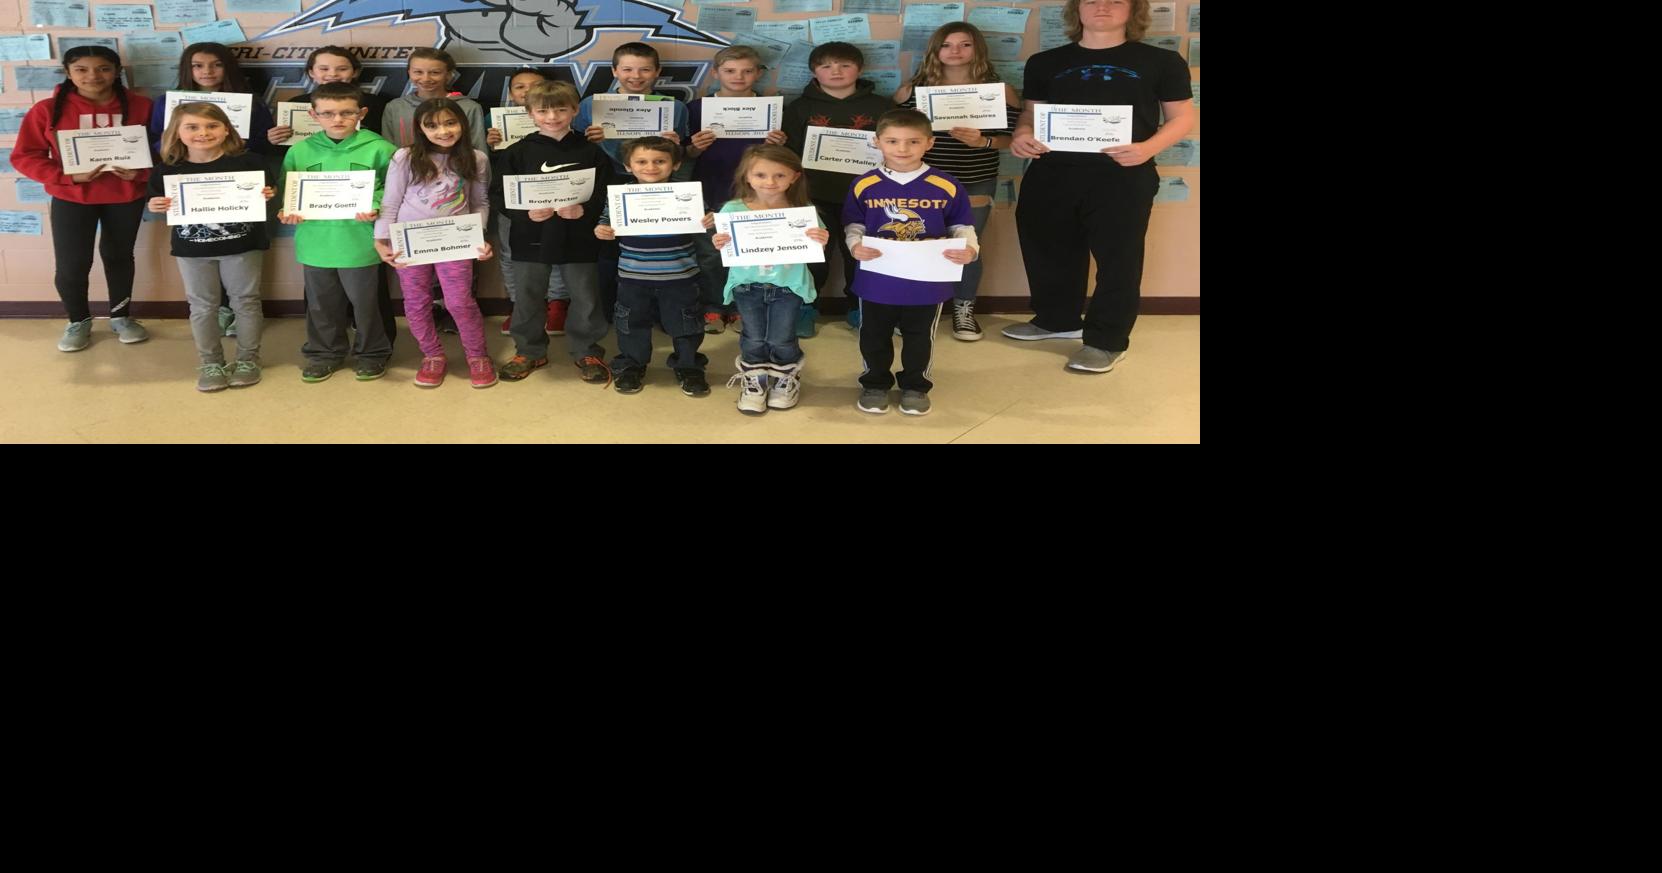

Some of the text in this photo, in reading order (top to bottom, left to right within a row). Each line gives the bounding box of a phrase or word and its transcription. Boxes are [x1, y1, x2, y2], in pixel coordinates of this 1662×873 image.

[230, 46, 414, 59] TRI-CIT NITE
[1087, 135, 1120, 143] O'Keefe
[820, 155, 877, 167] Carter O'Malley
[864, 198, 948, 209] INNESOT
[440, 243, 472, 252] Bohmer
[741, 244, 809, 254] Lindzey Jenson
